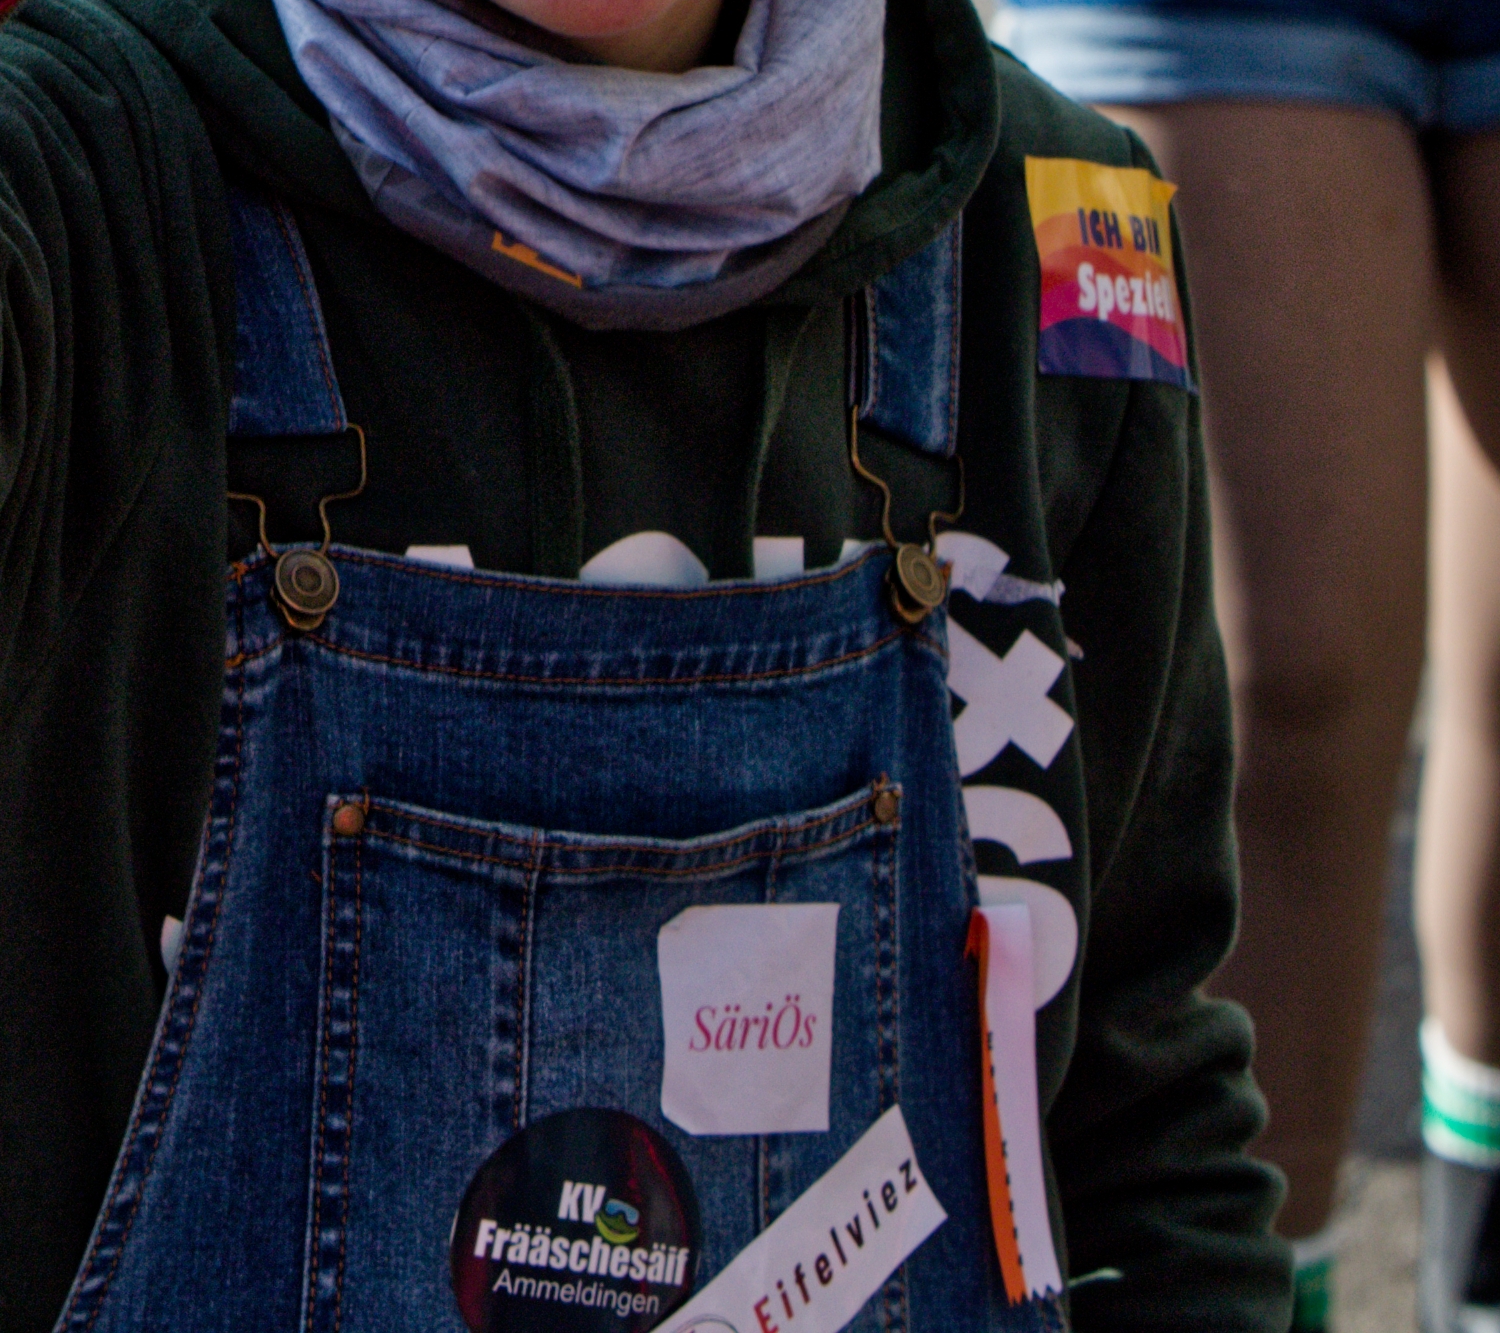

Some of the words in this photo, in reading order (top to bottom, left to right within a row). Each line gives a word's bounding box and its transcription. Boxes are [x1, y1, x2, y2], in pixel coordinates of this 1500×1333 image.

[1077, 206, 1123, 250] ICH
[688, 992, 818, 1053] SäriÖs
[557, 1179, 607, 1225] KV
[473, 1218, 691, 1288] Frääschesäif
[752, 1158, 919, 1333] Eifelviez
[491, 1268, 660, 1319] Ammeldingen
